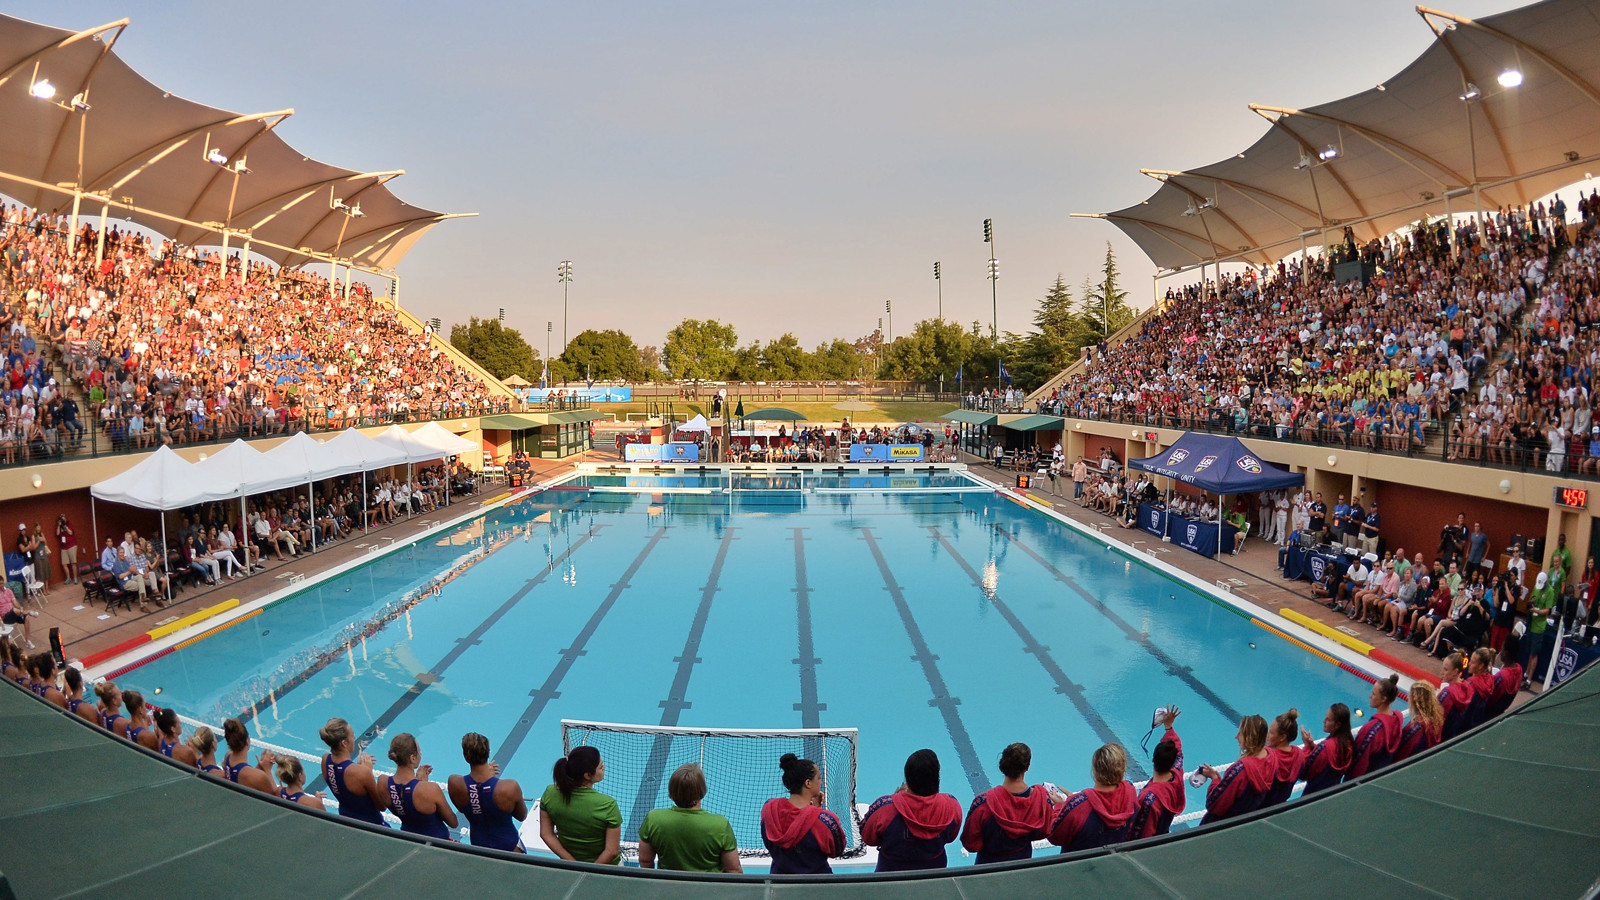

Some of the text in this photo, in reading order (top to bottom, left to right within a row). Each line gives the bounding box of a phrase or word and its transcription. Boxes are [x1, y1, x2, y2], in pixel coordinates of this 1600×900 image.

[1180, 473, 1196, 484] UNITY
[1563, 488, 1586, 507] 4:59
[328, 764, 340, 795] RUSSIA
[390, 784, 406, 816] RUSSIA
[469, 783, 482, 815] RUSSIA
